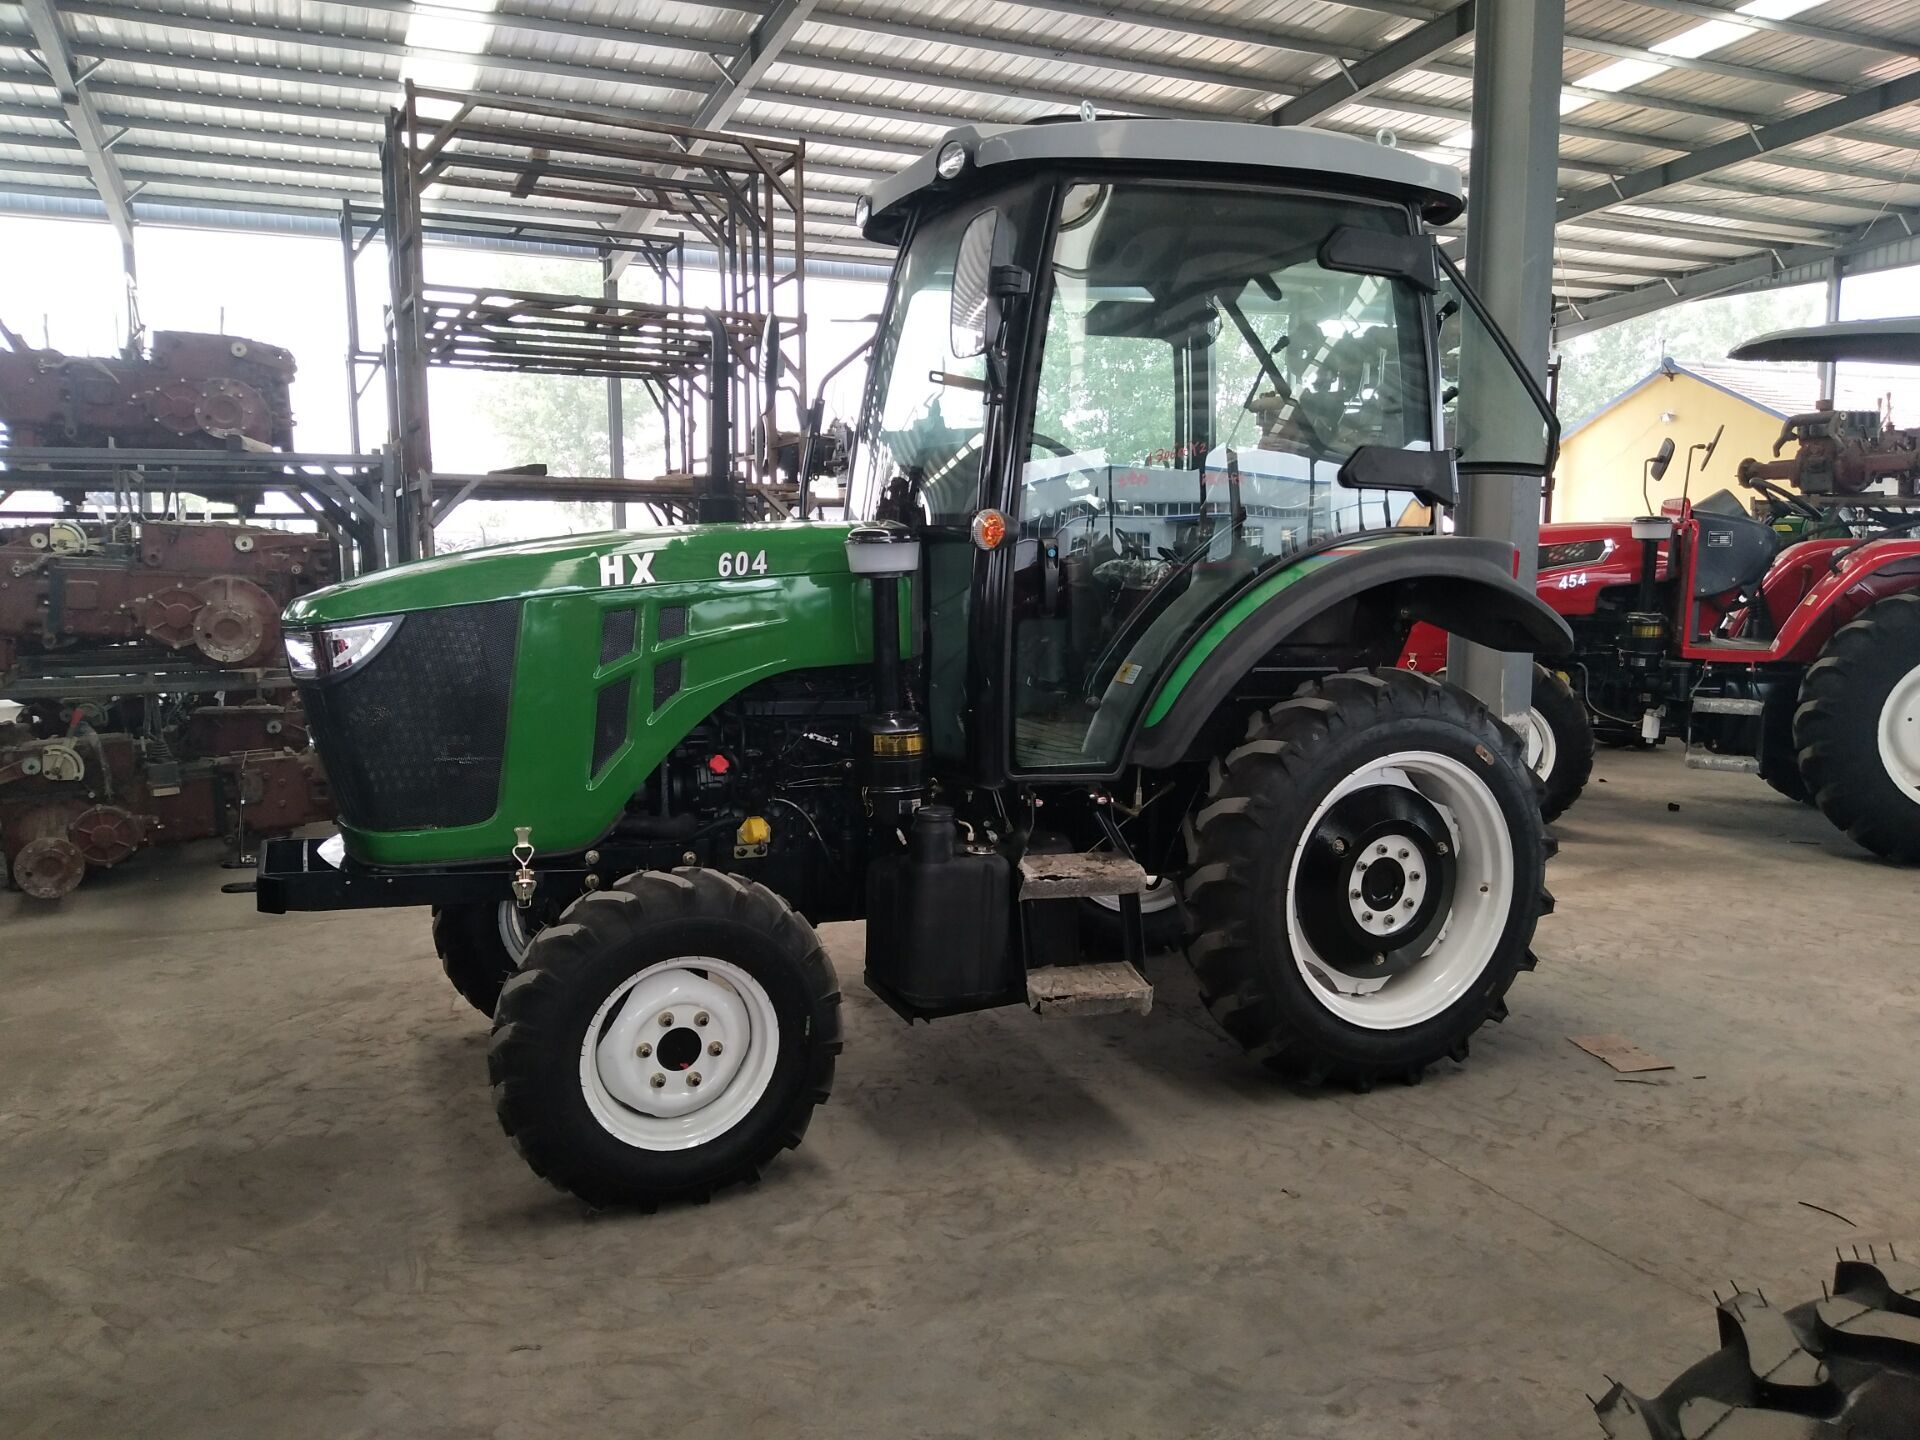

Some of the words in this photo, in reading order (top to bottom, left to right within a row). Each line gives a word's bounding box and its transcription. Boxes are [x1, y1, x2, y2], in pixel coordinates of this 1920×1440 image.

[600, 552, 656, 587] HX
[718, 550, 768, 577] 604
[1558, 572, 1587, 590] 454
